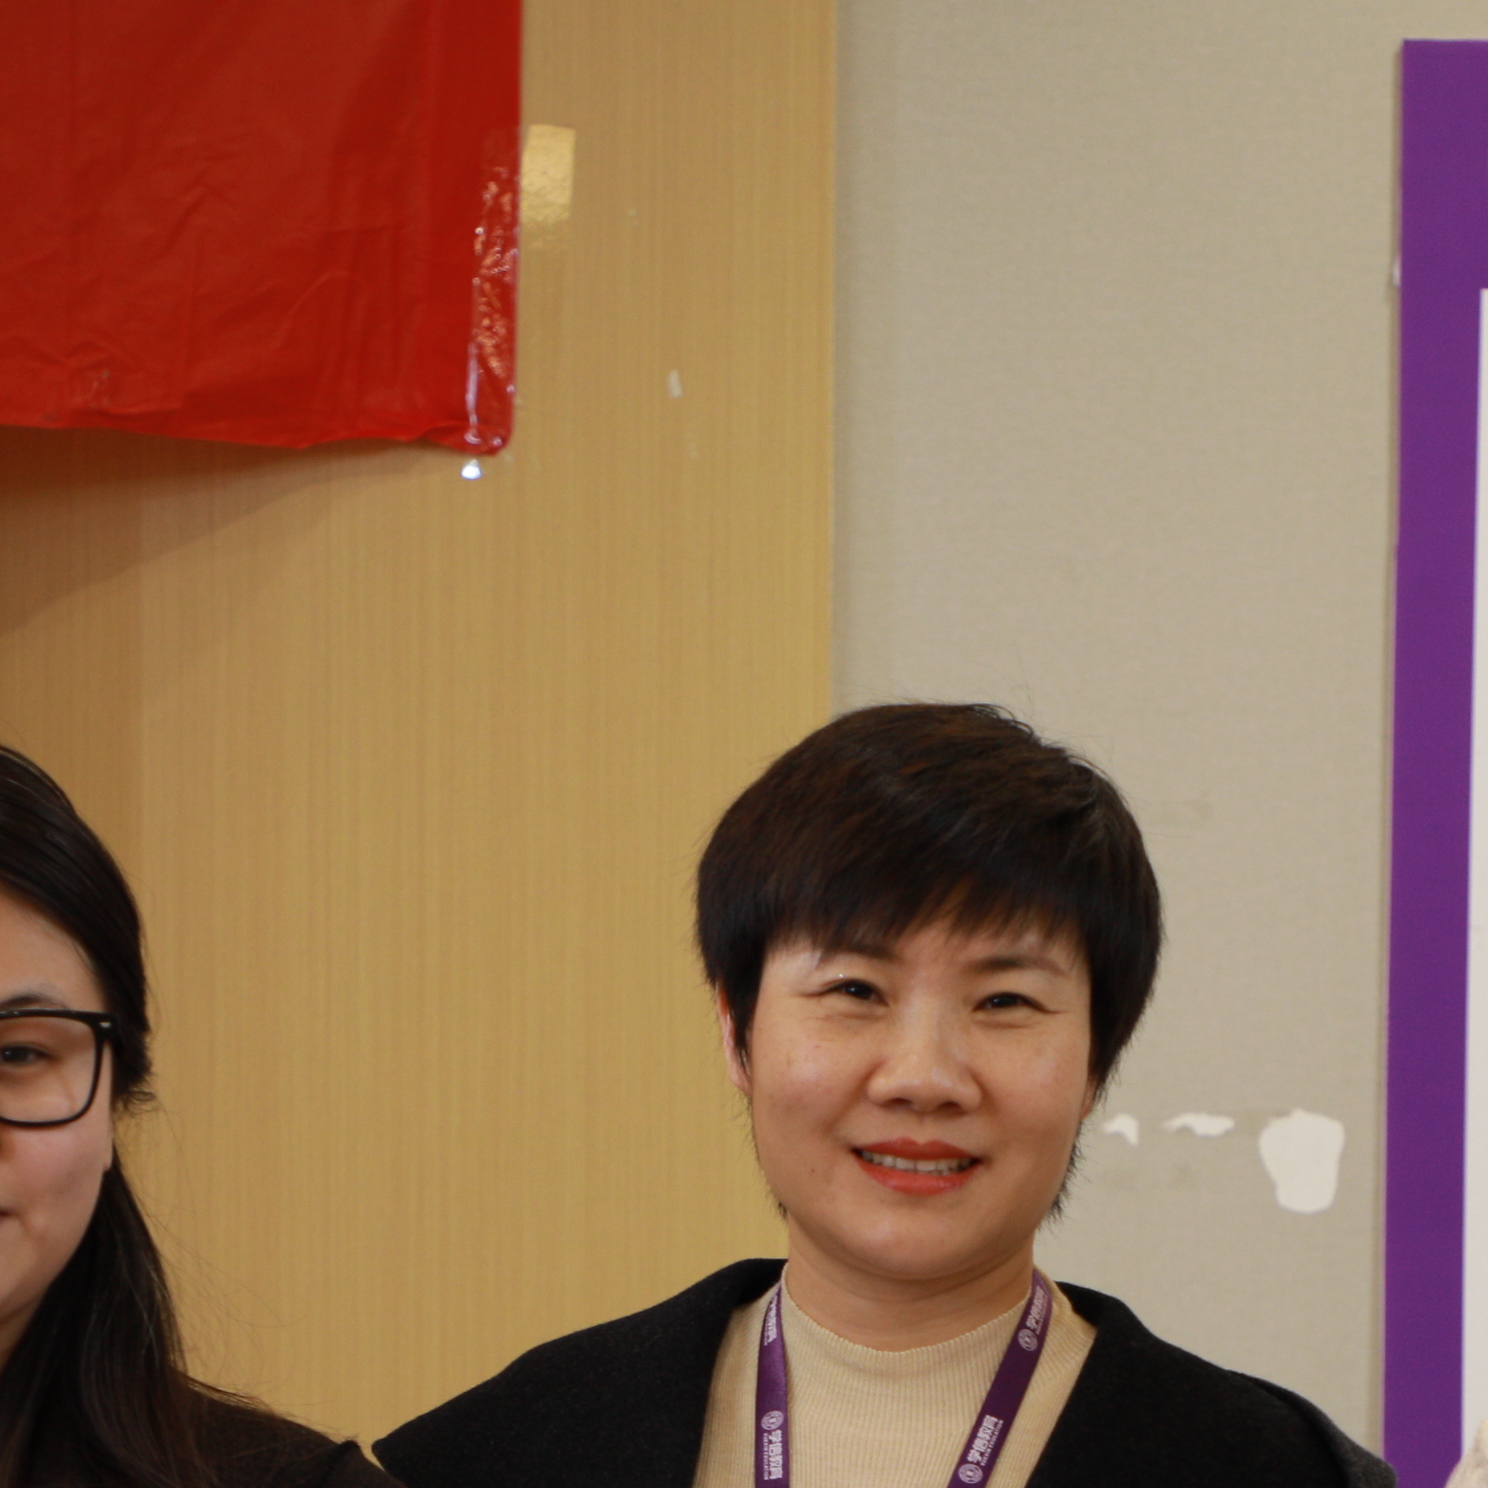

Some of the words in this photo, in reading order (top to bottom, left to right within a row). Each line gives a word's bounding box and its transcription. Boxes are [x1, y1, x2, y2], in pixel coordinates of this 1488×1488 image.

[768, 1429, 783, 1480] 学信教育
[967, 1414, 998, 1463] 学信教育
